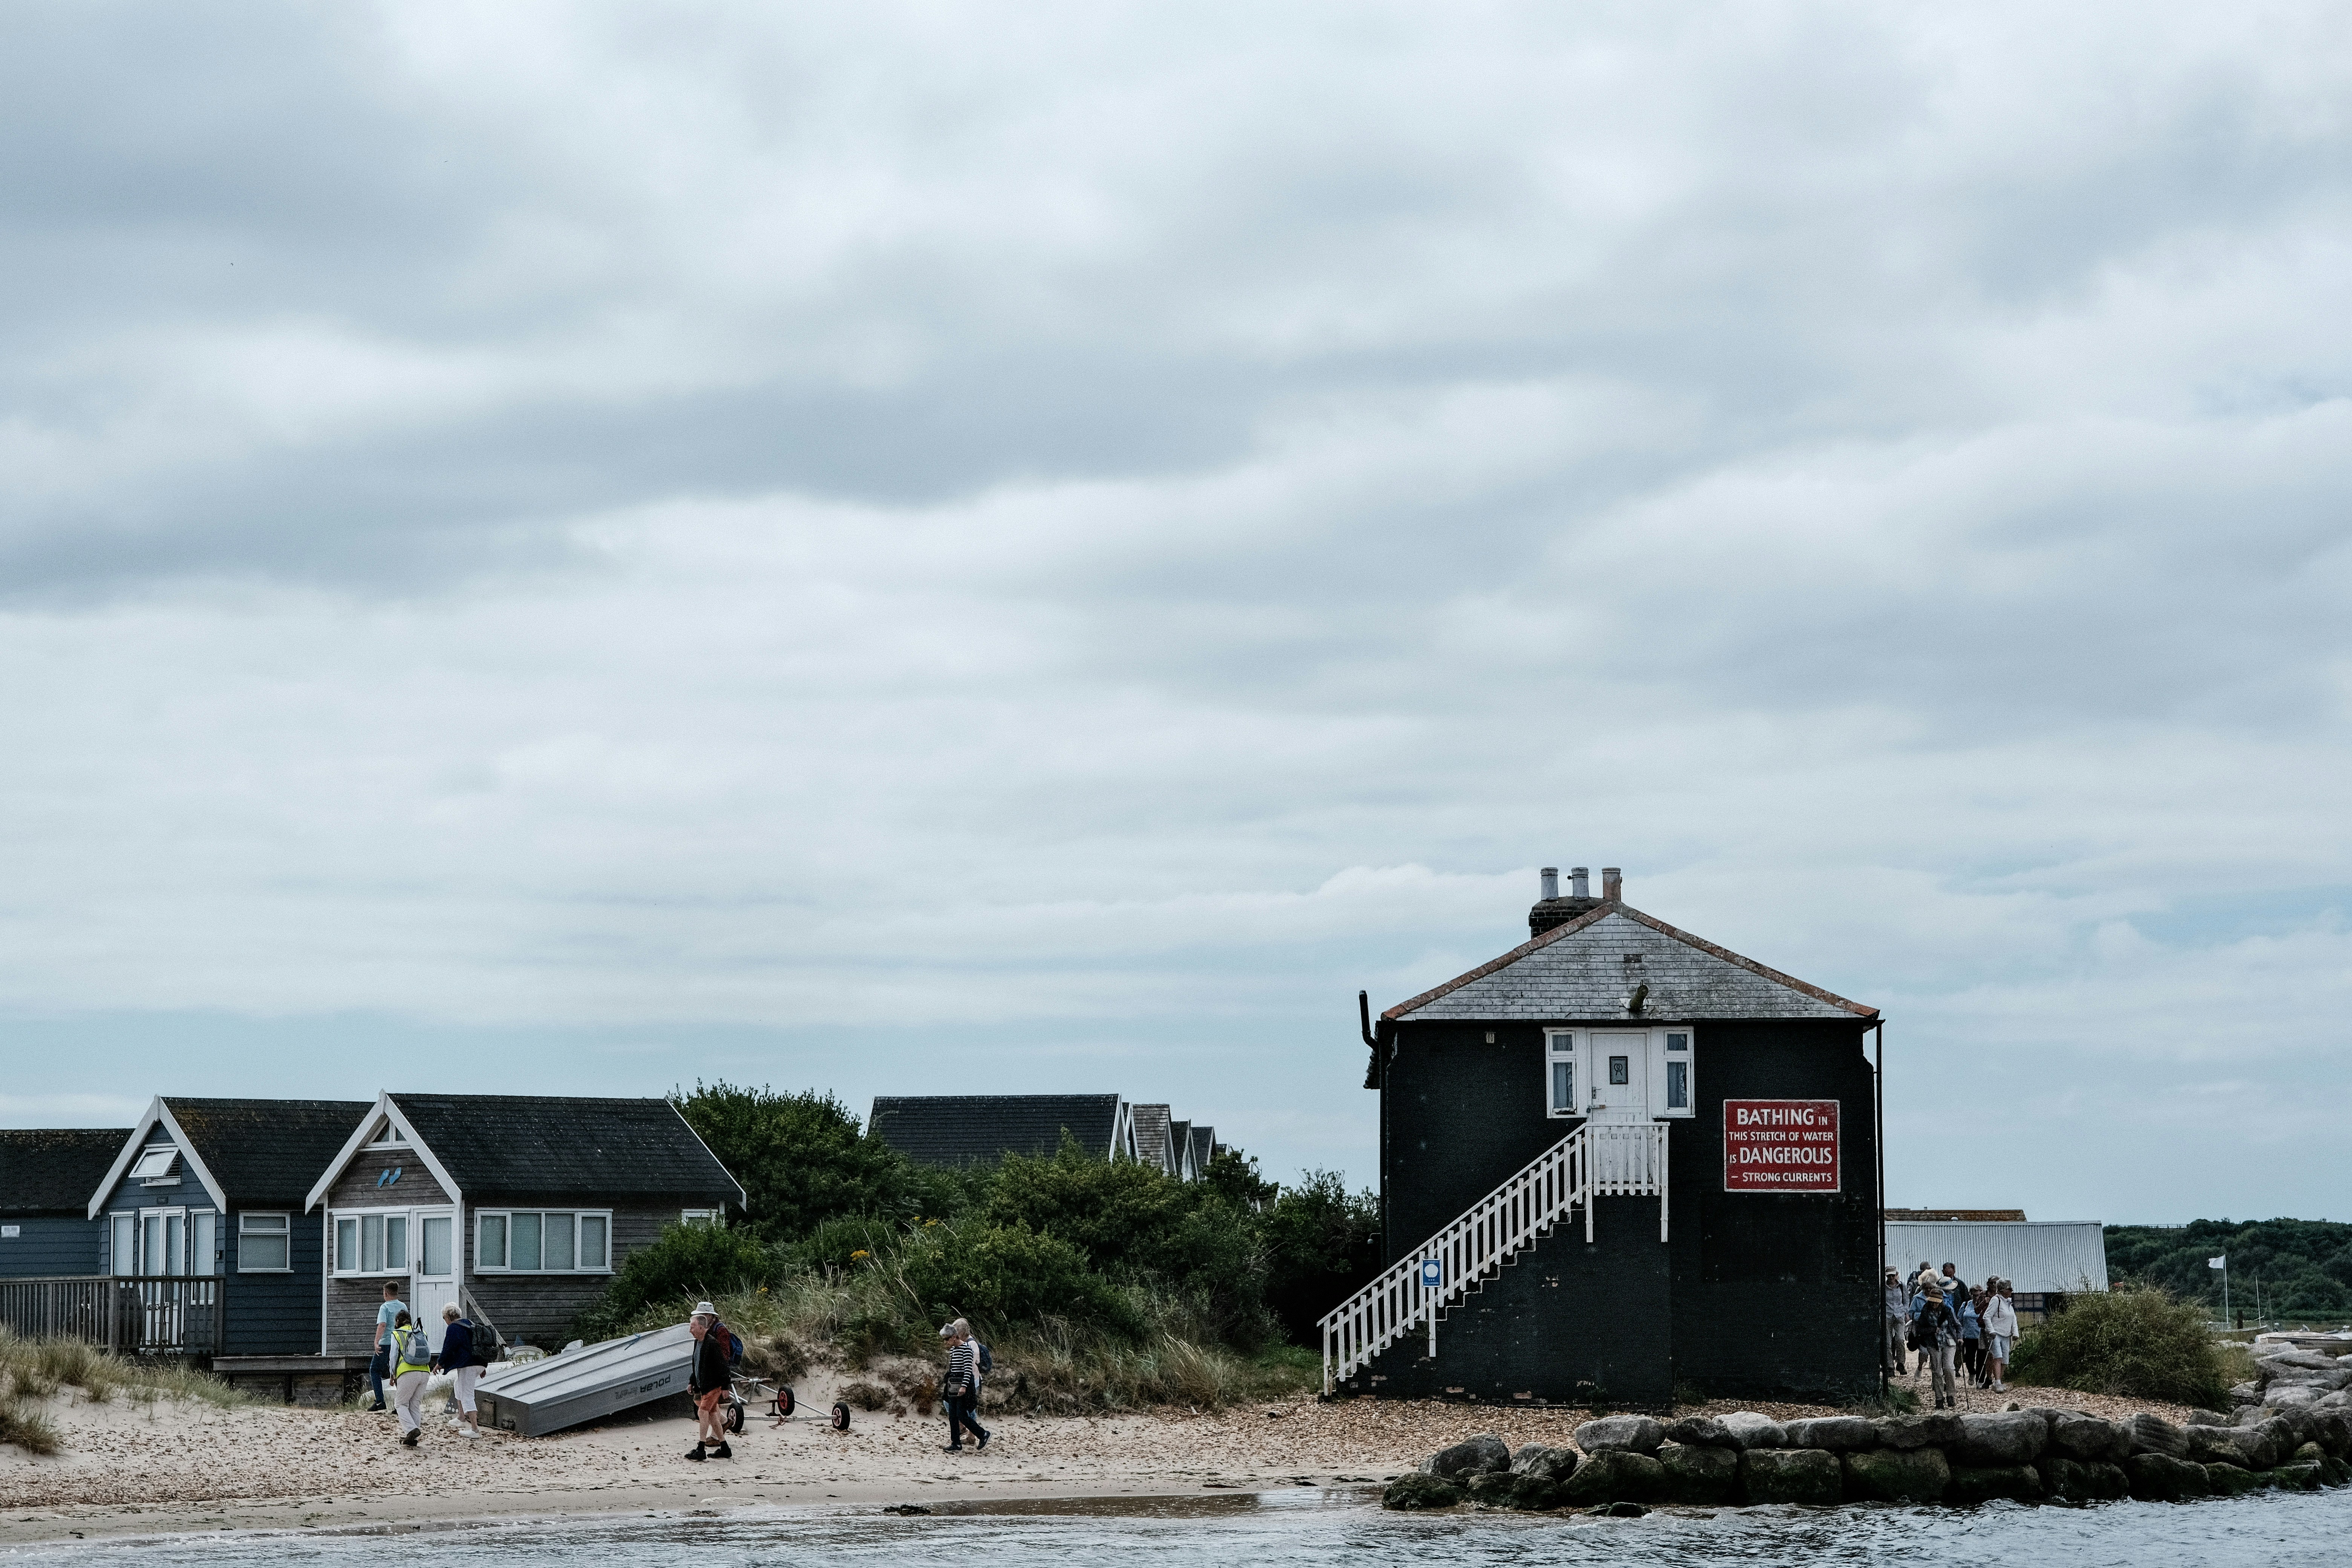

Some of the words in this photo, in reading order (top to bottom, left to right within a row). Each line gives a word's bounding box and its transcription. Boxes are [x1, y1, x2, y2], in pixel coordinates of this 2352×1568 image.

[1737, 1109, 1814, 1125] BATHING
[1819, 1116, 1827, 1125] IN
[1729, 1132, 1747, 1140] THIS
[1750, 1132, 1785, 1141] STRETCH
[1789, 1132, 1799, 1141] OF
[1802, 1132, 1833, 1141] WATER
[1730, 1155, 1736, 1163] IS
[1740, 1147, 1832, 1164] DANGEROUS
[1743, 1172, 1780, 1182] STRONG
[1783, 1173, 1832, 1182] CURRENTS
